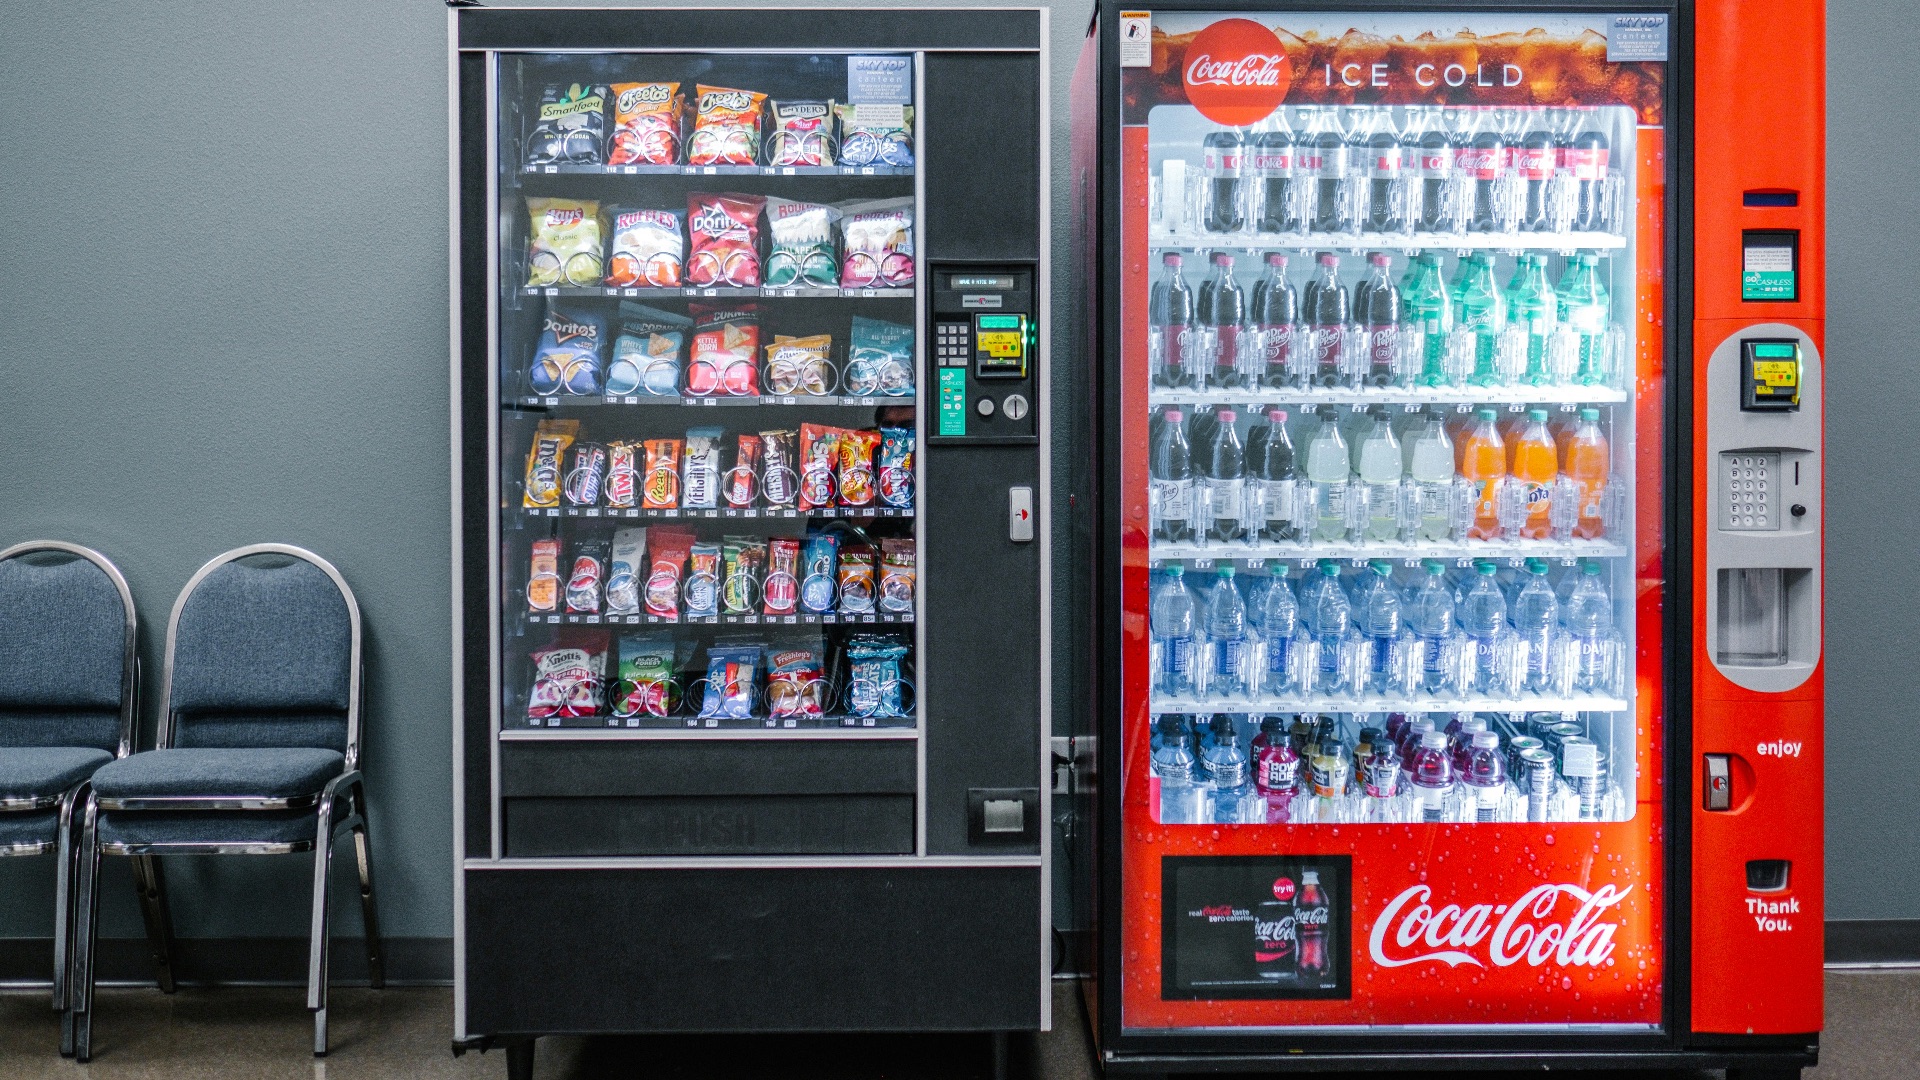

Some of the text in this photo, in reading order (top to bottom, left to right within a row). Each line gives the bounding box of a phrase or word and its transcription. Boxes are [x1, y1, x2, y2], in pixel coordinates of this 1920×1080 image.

[1614, 17, 1665, 28] SKY TOP
[1186, 54, 1285, 87] Coca-Cola
[1324, 63, 1524, 87] ICE COLD
[543, 99, 600, 117] Smartfood
[618, 85, 670, 114] Cheetos
[699, 91, 752, 114] Cheetos
[781, 106, 824, 114] SNYDER'S
[1256, 156, 1283, 169] Coke
[617, 209, 676, 230] RUFFLES
[543, 318, 597, 337] Doritos
[1466, 314, 1492, 325] Sprite
[546, 652, 582, 667] Knott's
[1756, 739, 1802, 758] enjoy
[1274, 885, 1286, 894] try
[1189, 910, 1203, 918] real
[1744, 897, 1800, 915] Thank
[1209, 914, 1254, 923] zero calories
[1369, 883, 1634, 969] Coca-Cola
[1755, 916, 1792, 932] You.
[1264, 940, 1287, 949] zero
